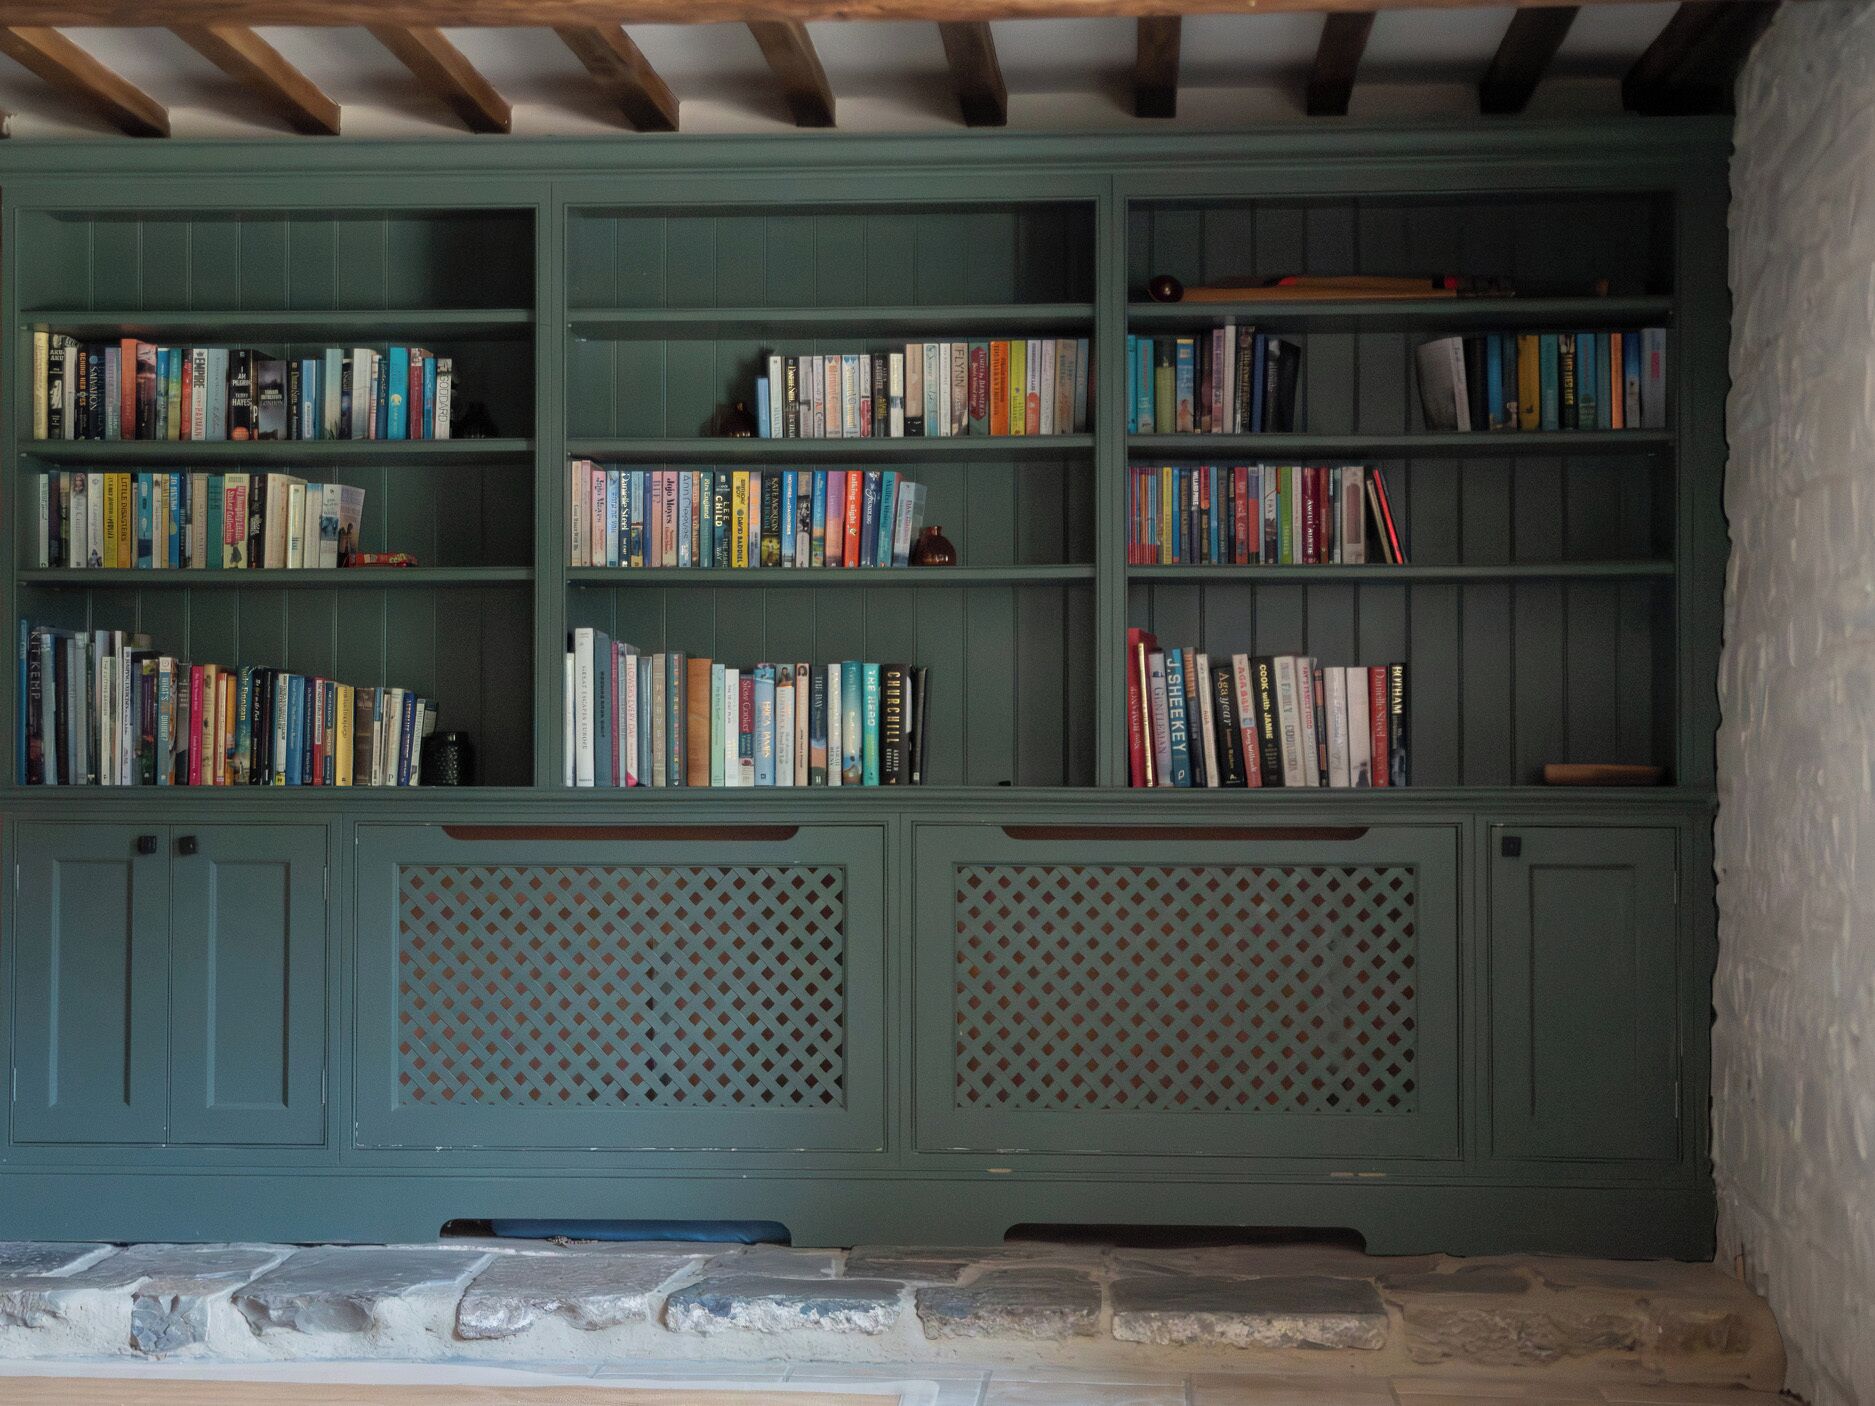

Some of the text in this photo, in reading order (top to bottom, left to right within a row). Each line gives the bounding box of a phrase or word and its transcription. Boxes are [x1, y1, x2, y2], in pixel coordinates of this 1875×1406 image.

[89, 366, 98, 411] SALVATION
[193, 357, 205, 389] EMPIRE
[954, 349, 965, 389] FLYNN
[232, 399, 252, 407] HAYES
[437, 375, 449, 423] GODDARD
[194, 407, 204, 438] PAXMAN
[120, 477, 129, 542] LITTLE DISASTERS
[595, 477, 605, 523] Jojo Moyes
[620, 473, 630, 531] Danielle Steel
[664, 478, 675, 524] Jojo Moyes
[681, 475, 692, 540] Ann Cleeves
[702, 478, 711, 520] Mrs England
[715, 495, 723, 528] CHILD
[770, 477, 780, 532] KATE MORTON
[848, 473, 858, 525] talking night
[736, 516, 744, 564] DAVID BADDIEL
[1307, 527, 1315, 555] AUNTIE
[30, 631, 42, 701] KIT KEMP
[867, 670, 876, 692] THE
[1238, 666, 1247, 690] AGA
[161, 677, 169, 701] WHAT'S
[240, 686, 249, 721] Finnigan
[741, 680, 752, 733] Slow Cooker
[814, 676, 823, 709] THE BAY
[886, 671, 901, 744] CHURCHILL
[1167, 658, 1187, 752] J.SHEEKEY
[1218, 671, 1232, 727] Aga year
[1259, 663, 1274, 740] COOK with JAMIE
[1280, 682, 1293, 713] FAMILY
[1374, 669, 1386, 709] Danielle
[160, 715, 169, 742] DINNER?
[762, 701, 772, 758] ERICA JAMES
[1154, 686, 1167, 755] GENTLEMAN
[1245, 728, 1253, 744] Amy
[1375, 710, 1387, 737] Steel
[1284, 724, 1298, 772] COOKBOOK
